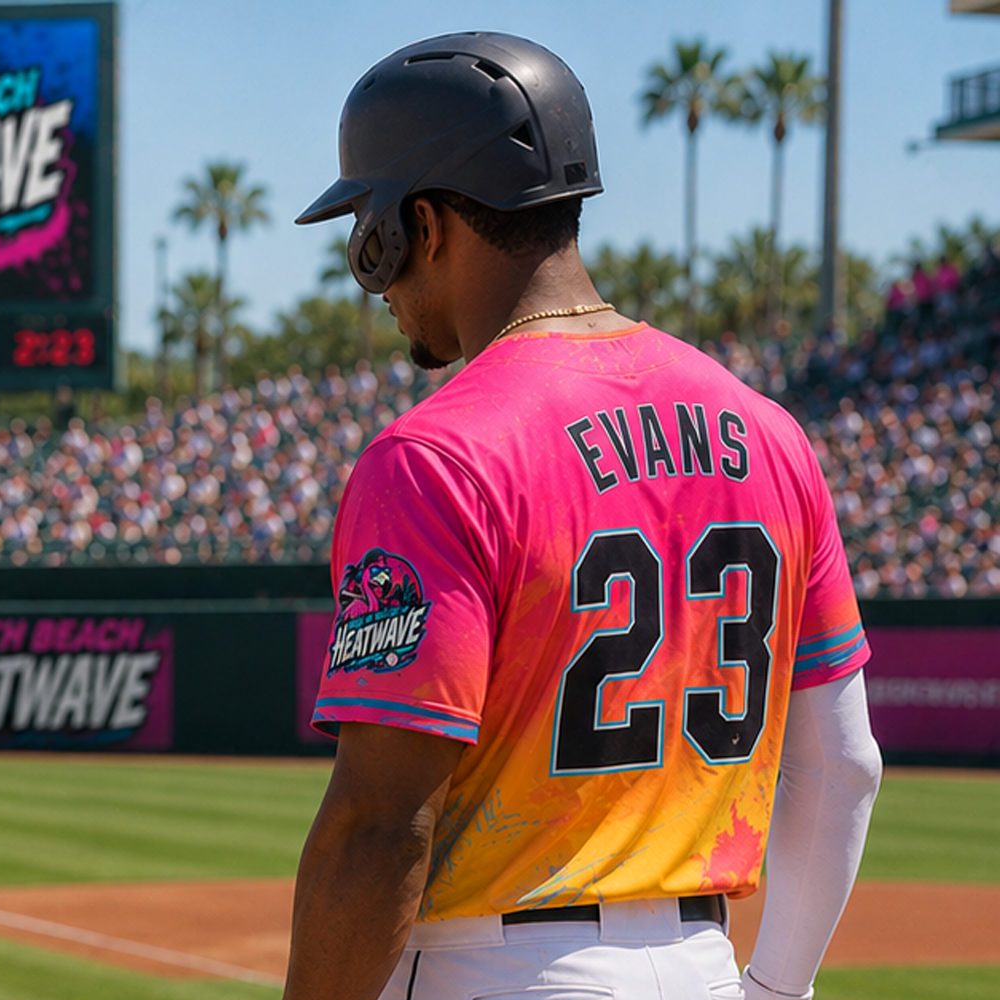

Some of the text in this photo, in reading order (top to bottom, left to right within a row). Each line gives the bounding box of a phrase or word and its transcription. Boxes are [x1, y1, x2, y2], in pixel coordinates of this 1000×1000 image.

[565, 402, 749, 493] EVANS
[31, 617, 144, 651] BEACH
[331, 606, 426, 667] HEATWAVE
[550, 521, 782, 777] 23
